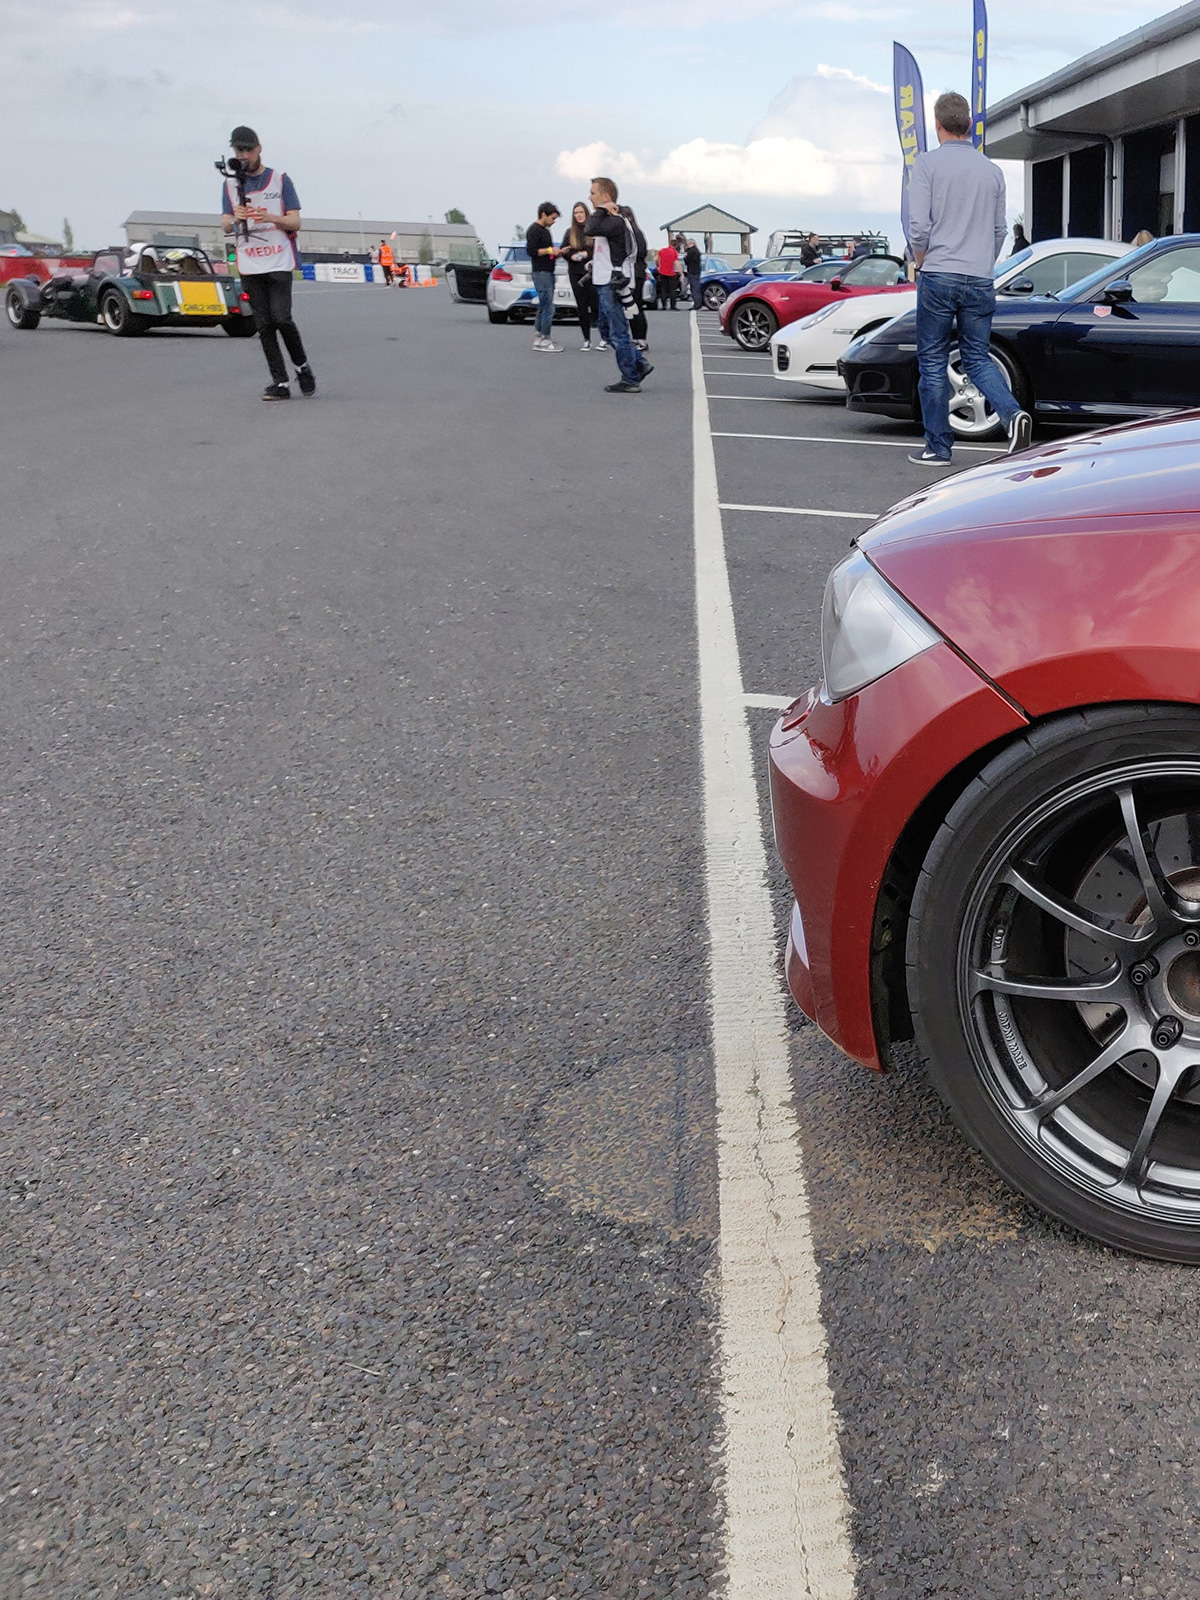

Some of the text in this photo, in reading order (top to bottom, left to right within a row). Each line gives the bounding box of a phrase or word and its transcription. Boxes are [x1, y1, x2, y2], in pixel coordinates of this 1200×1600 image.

[245, 245, 283, 258] MEDIA
[332, 267, 359, 275] TRACK
[998, 1011, 1029, 1071] JAPAN MADE
